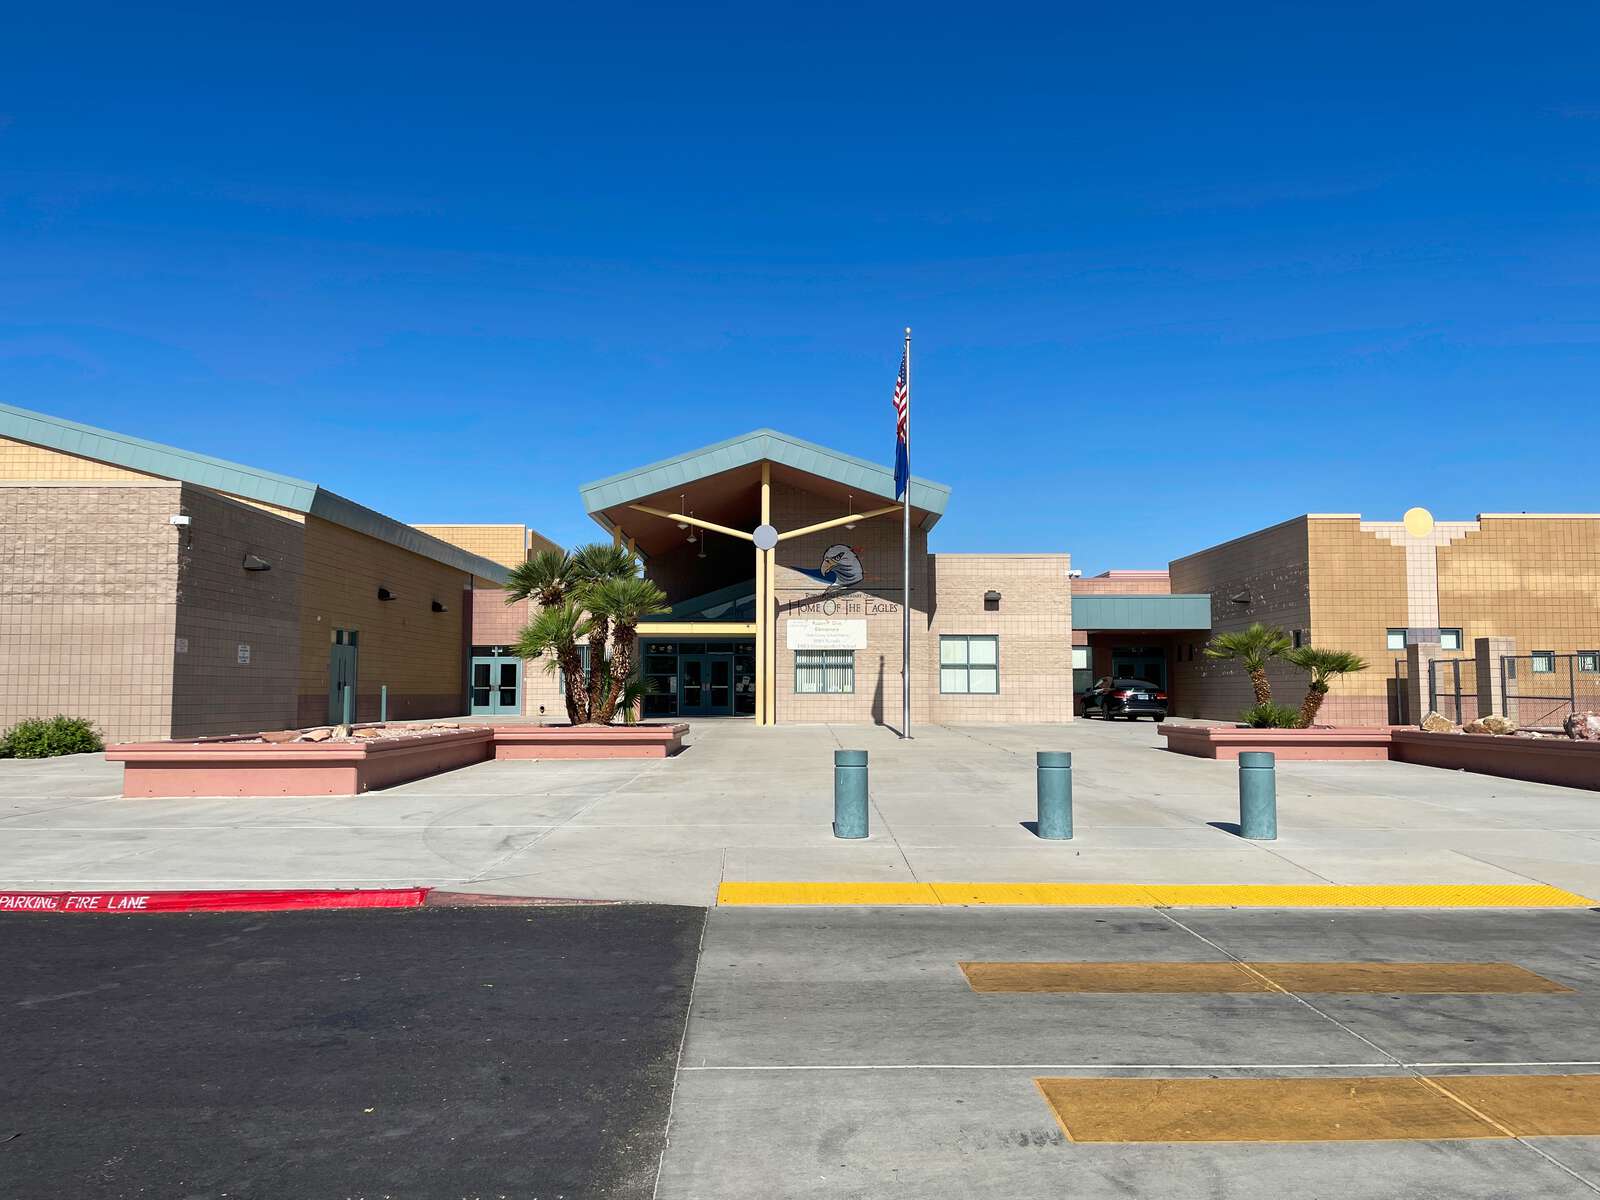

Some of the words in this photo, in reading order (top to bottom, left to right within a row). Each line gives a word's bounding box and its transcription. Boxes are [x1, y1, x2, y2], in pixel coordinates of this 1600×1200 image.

[0, 896, 58, 909] PARKING
[65, 896, 101, 909] FIRE
[107, 896, 150, 909] LANE
